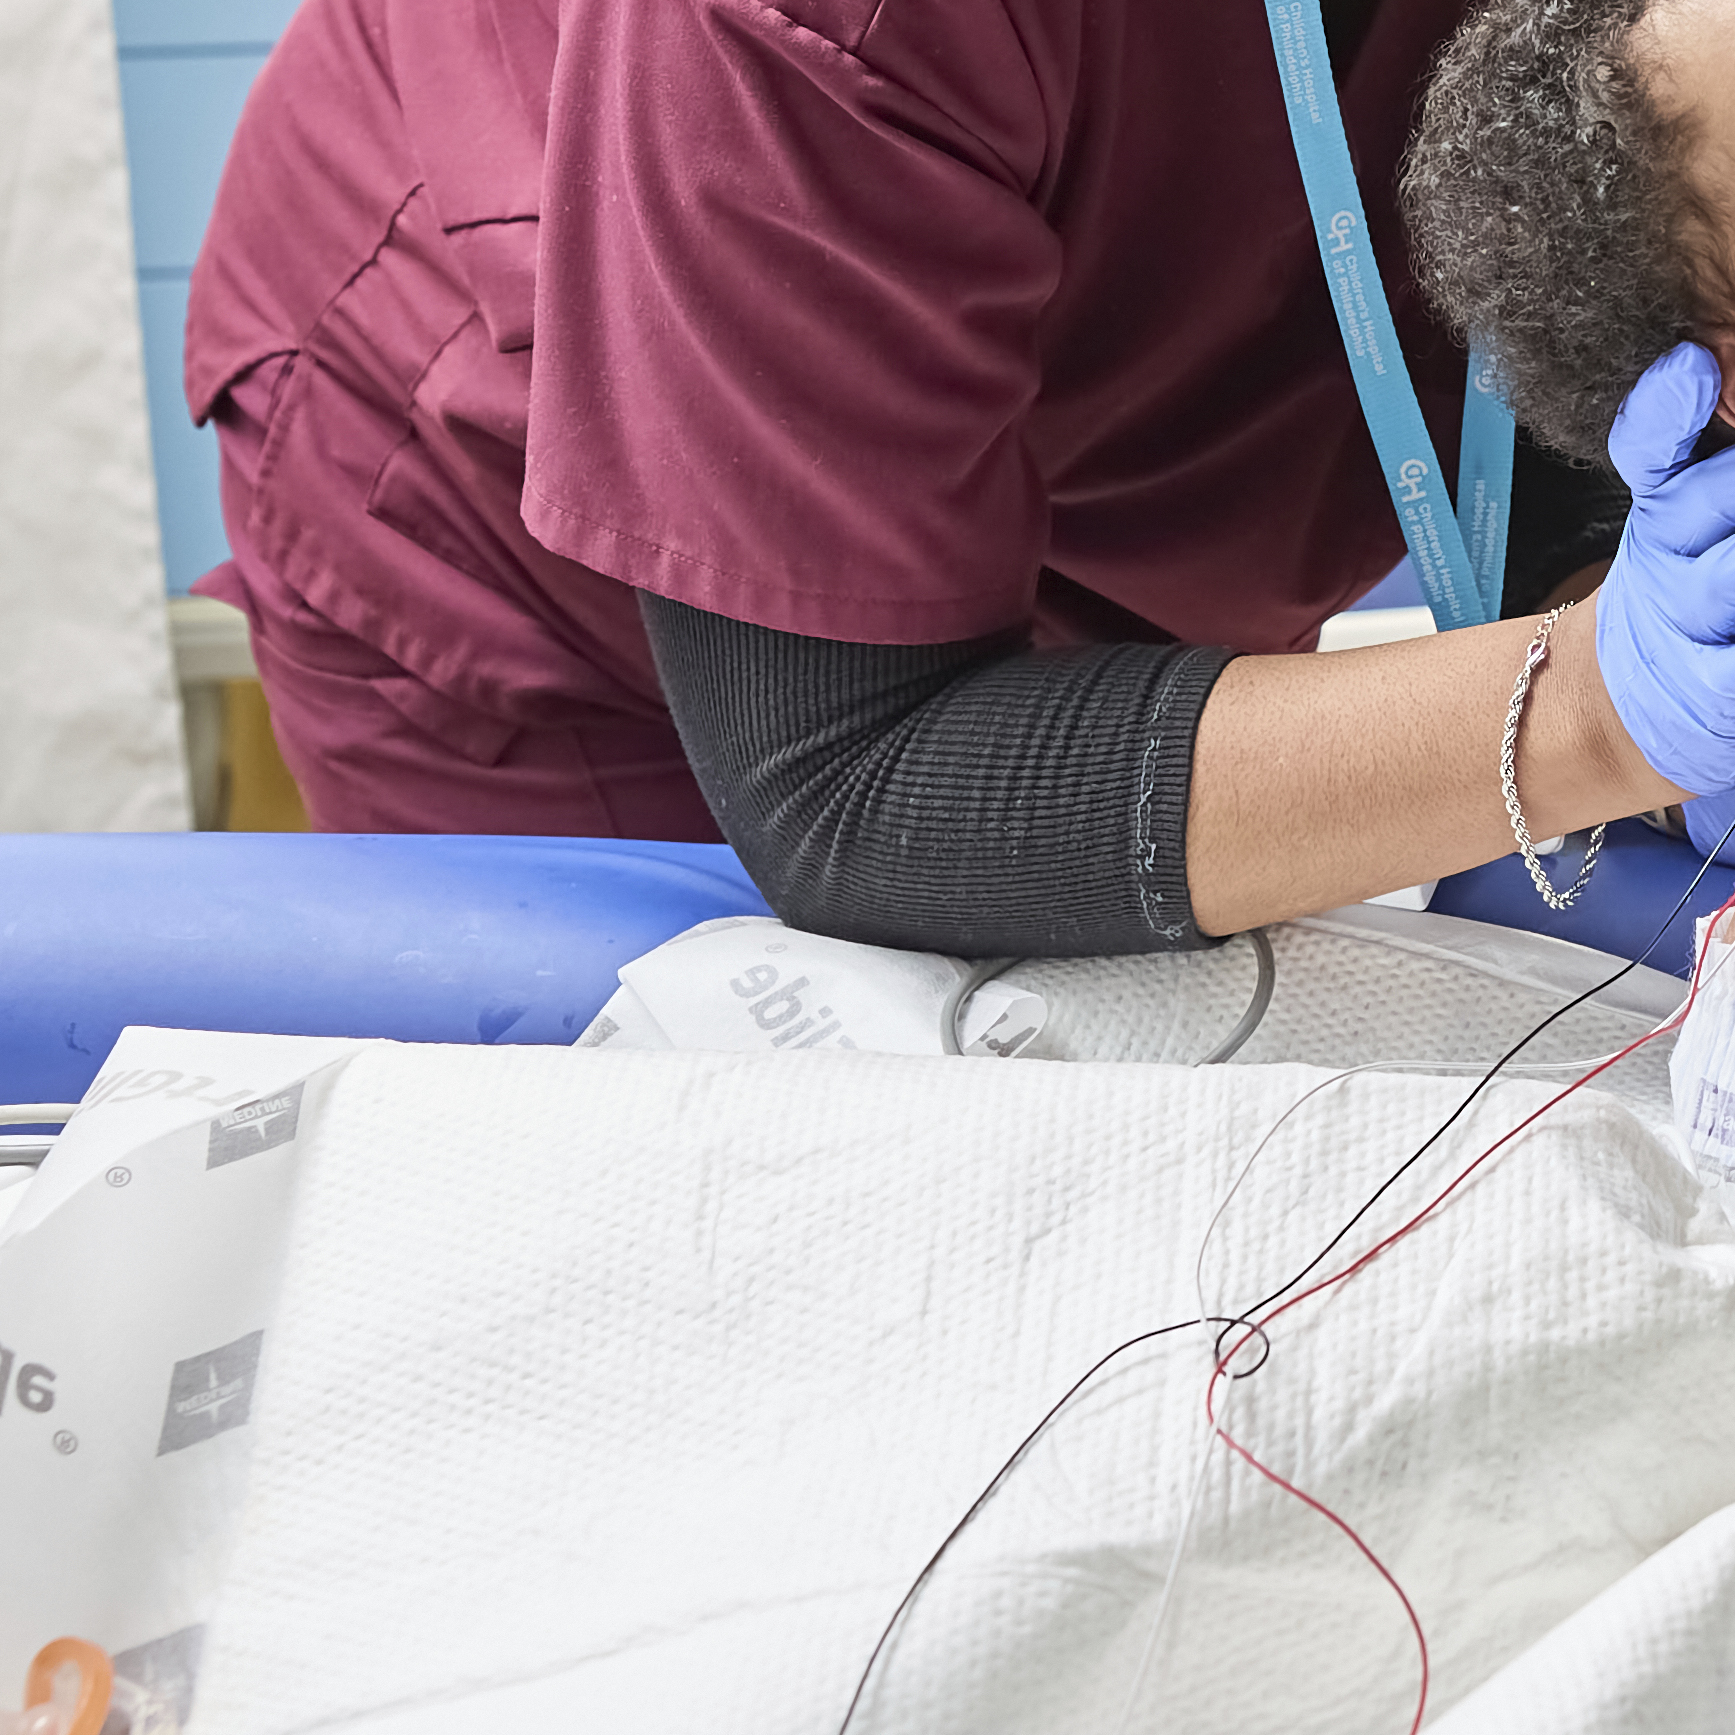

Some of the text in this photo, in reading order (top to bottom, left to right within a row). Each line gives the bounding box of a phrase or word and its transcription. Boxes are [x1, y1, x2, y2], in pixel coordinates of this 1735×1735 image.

[1276, 5, 1303, 104] of Philadelphia
[1290, 2, 1322, 124] Children's Hospital
[1332, 259, 1366, 357] of Philadelphia
[1345, 255, 1387, 376] Children's Hospital
[1404, 508, 1442, 603] of Philadelphia
[1418, 503, 1466, 622] Children's Hospital
